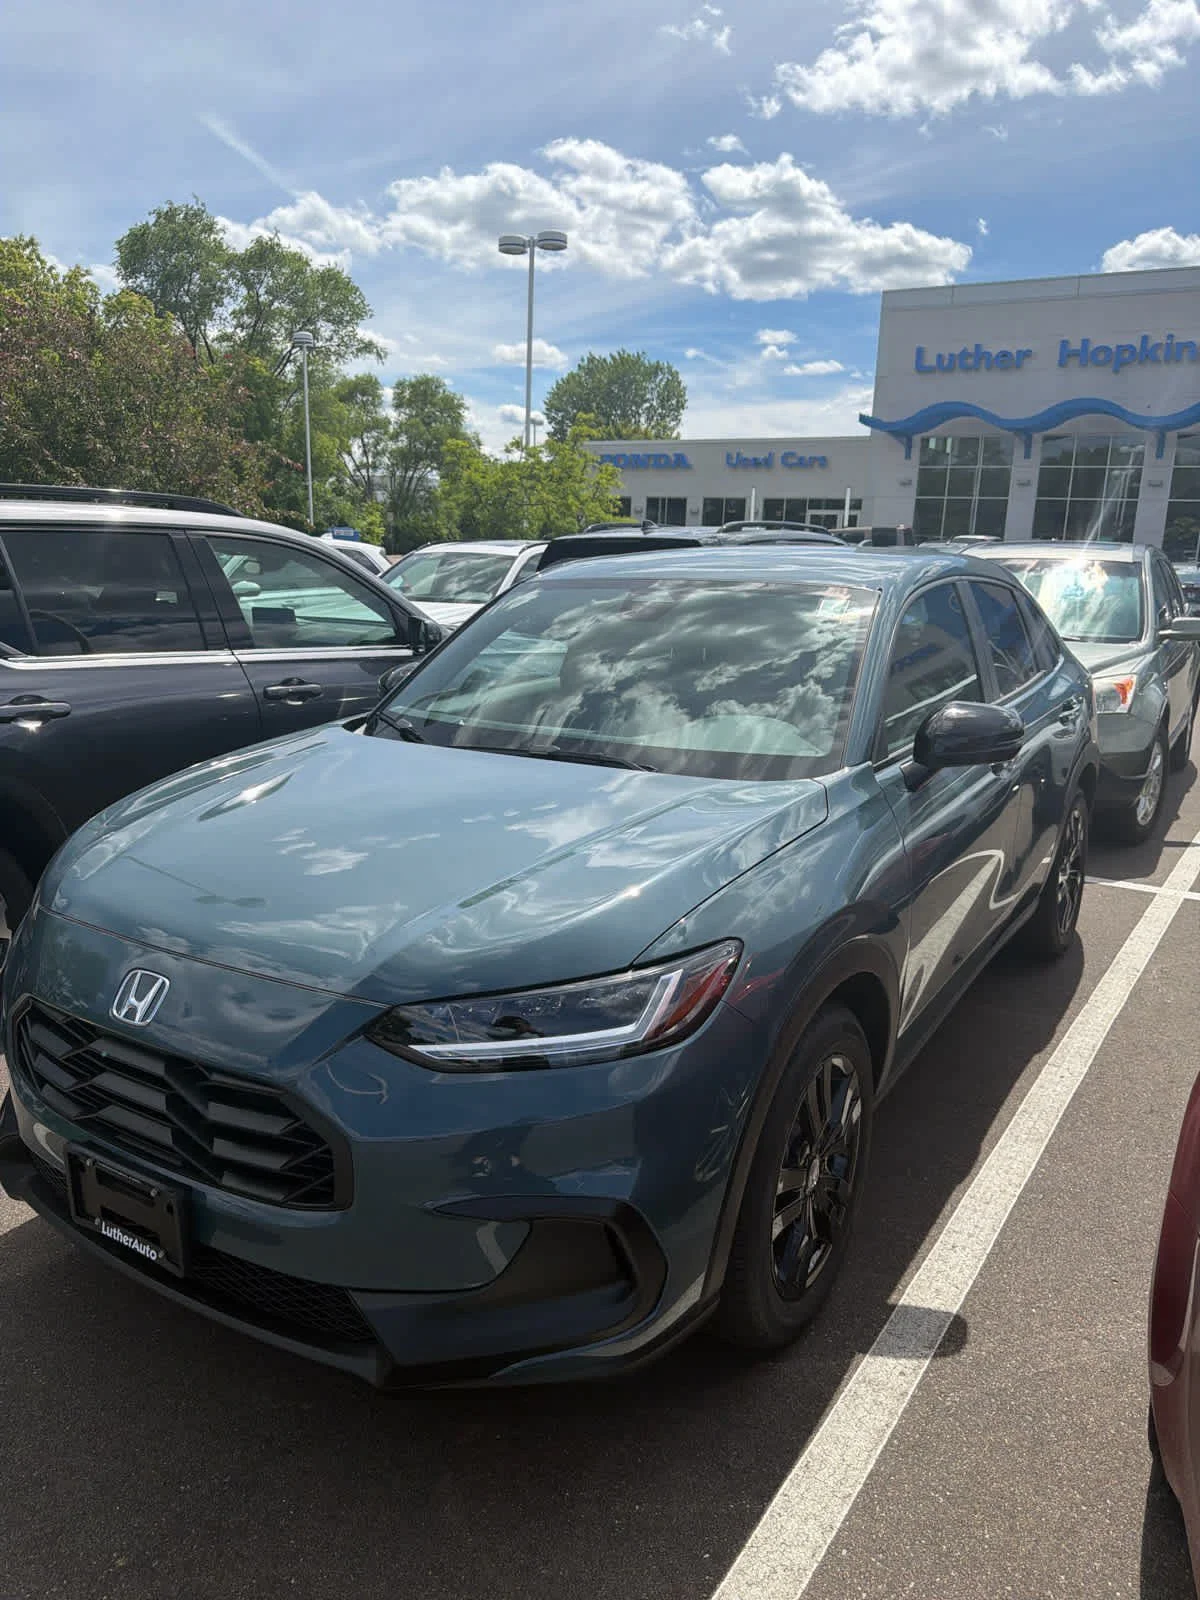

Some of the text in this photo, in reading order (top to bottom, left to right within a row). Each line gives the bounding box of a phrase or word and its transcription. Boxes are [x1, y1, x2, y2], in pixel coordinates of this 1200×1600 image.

[914, 333, 1198, 374] Luther Hopkin
[725, 450, 828, 469] Used Cars
[101, 1221, 158, 1261] LutherAuto
